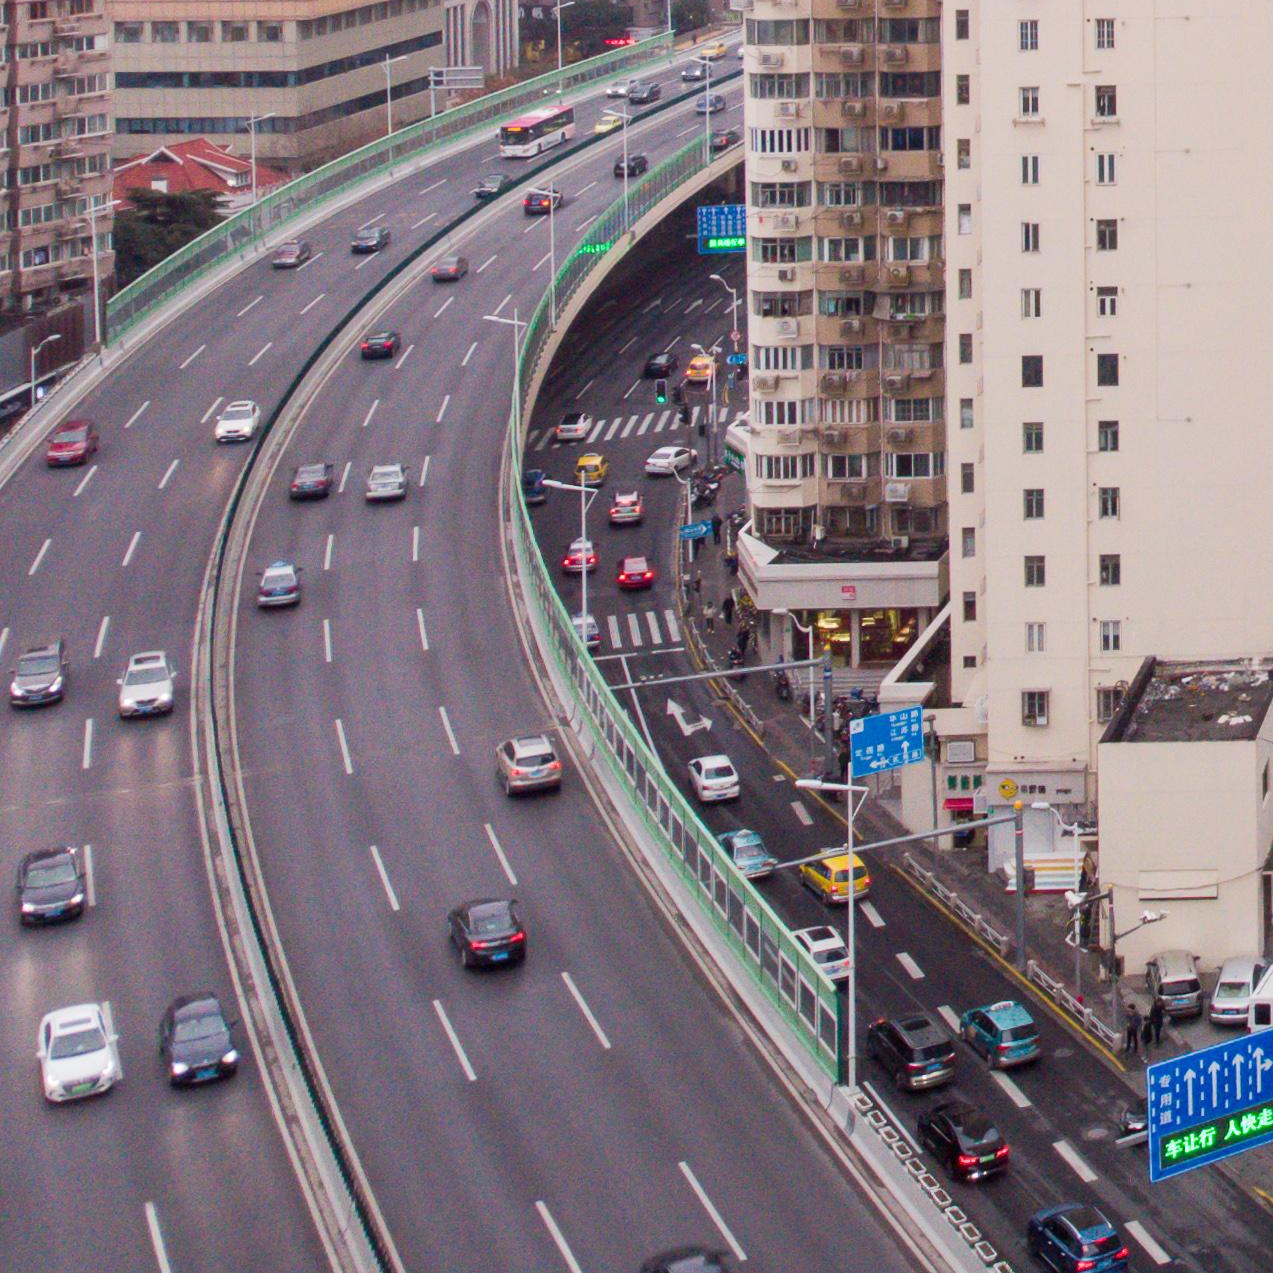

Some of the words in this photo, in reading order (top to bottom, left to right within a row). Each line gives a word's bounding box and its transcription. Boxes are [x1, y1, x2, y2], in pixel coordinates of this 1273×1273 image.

[1158, 1074, 1172, 1125] 专用道
[1164, 1125, 1217, 1160] 车让行
